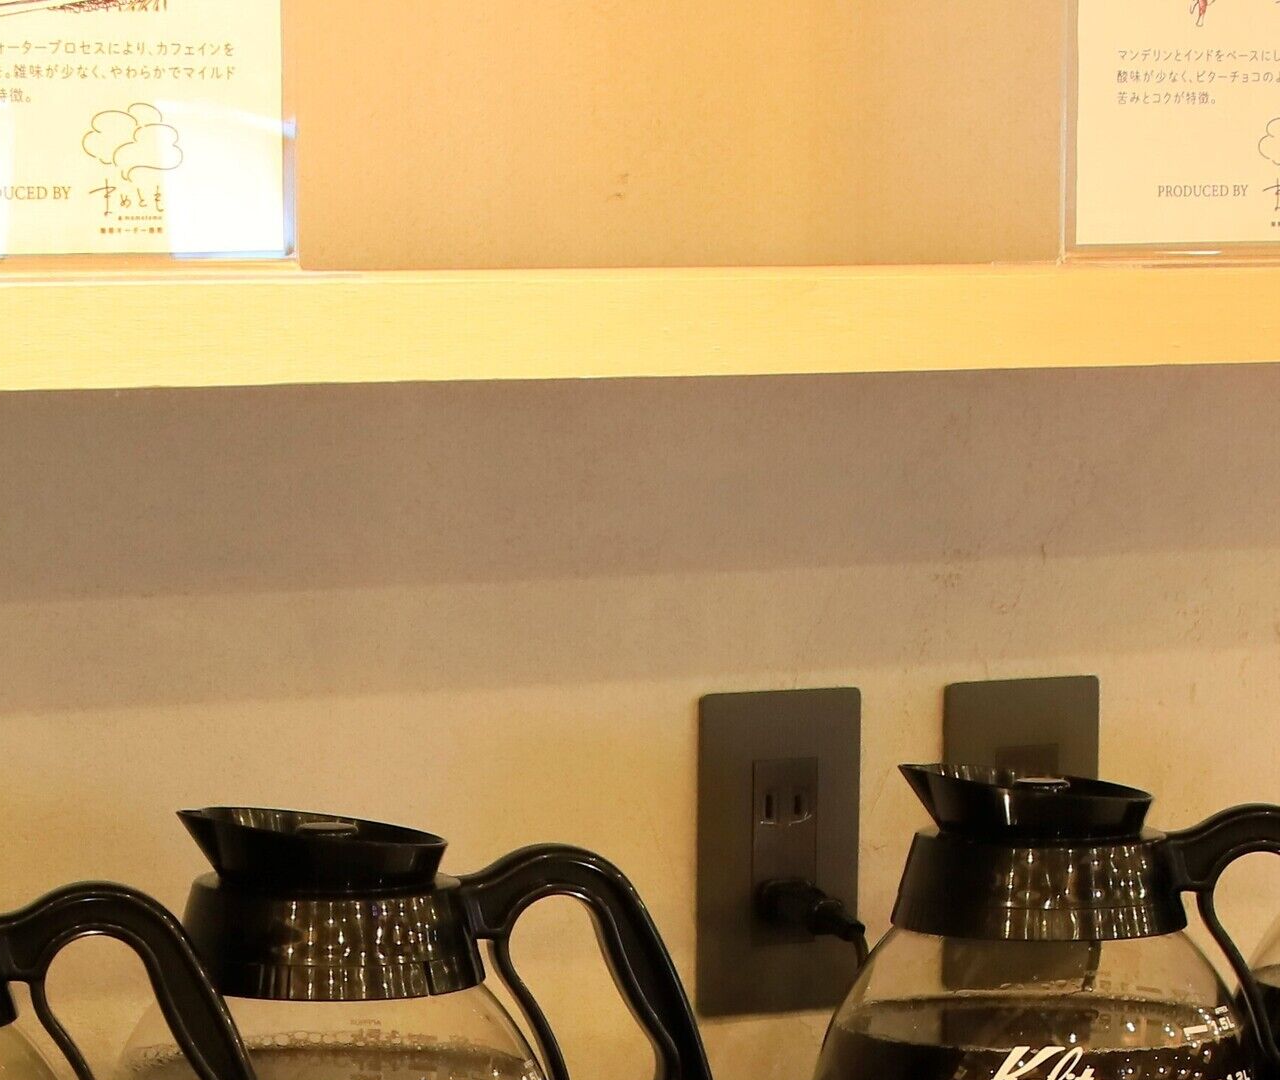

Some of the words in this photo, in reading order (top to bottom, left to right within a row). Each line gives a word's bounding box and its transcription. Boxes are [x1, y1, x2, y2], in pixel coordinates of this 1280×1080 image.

[1116, 91, 1216, 105] 苦みとコクが特徴。
[53, 186, 71, 200] BY
[1157, 185, 1229, 197] PRODUCED
[1232, 184, 1249, 197] BY
